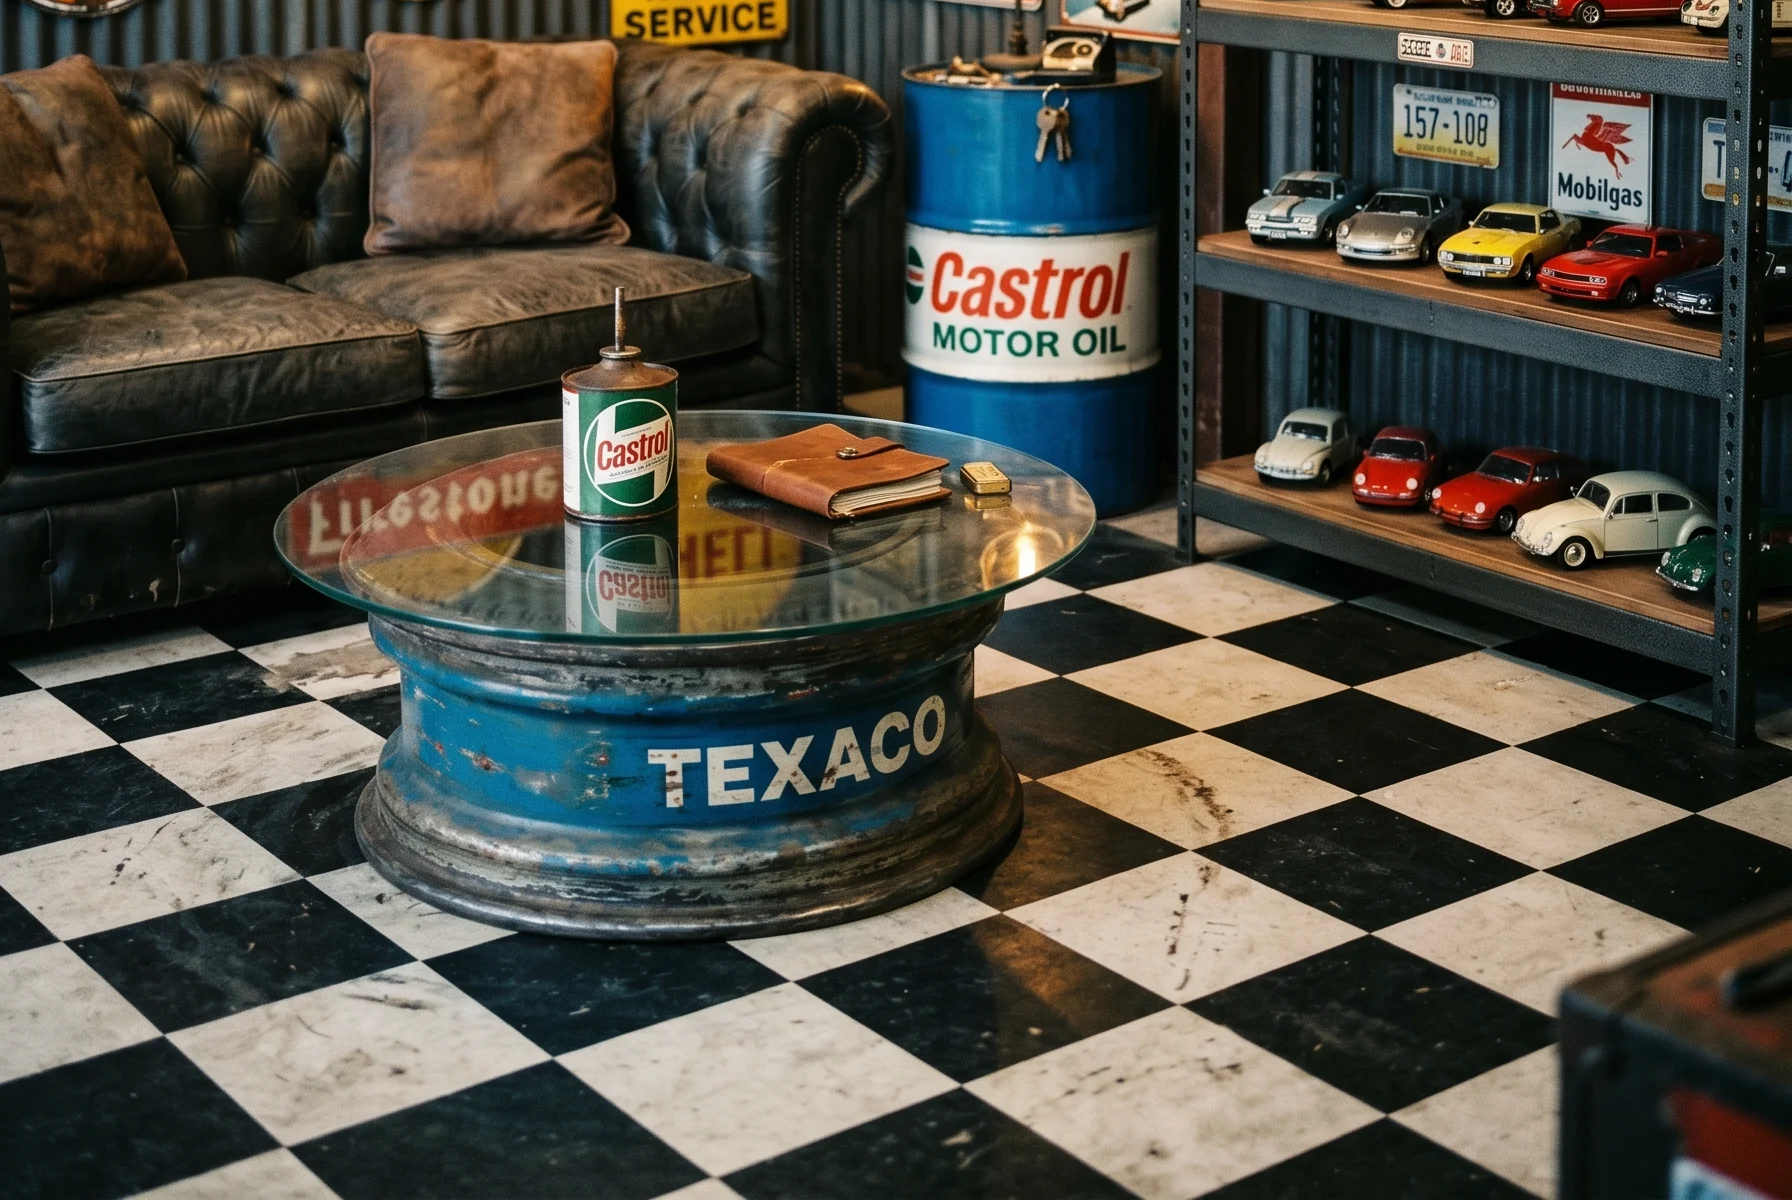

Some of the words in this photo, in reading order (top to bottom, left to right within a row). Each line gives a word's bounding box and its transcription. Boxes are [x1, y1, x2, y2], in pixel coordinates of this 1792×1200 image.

[625, 1, 776, 40] SERVICE
[1404, 104, 1488, 147] 157-108
[1558, 172, 1643, 211] Mobilgas
[930, 250, 1130, 320] Castrol
[933, 321, 1060, 357] MOTOR
[1073, 325, 1127, 356] OIL
[597, 420, 670, 471] Castrol
[648, 695, 946, 808] TEXACO
